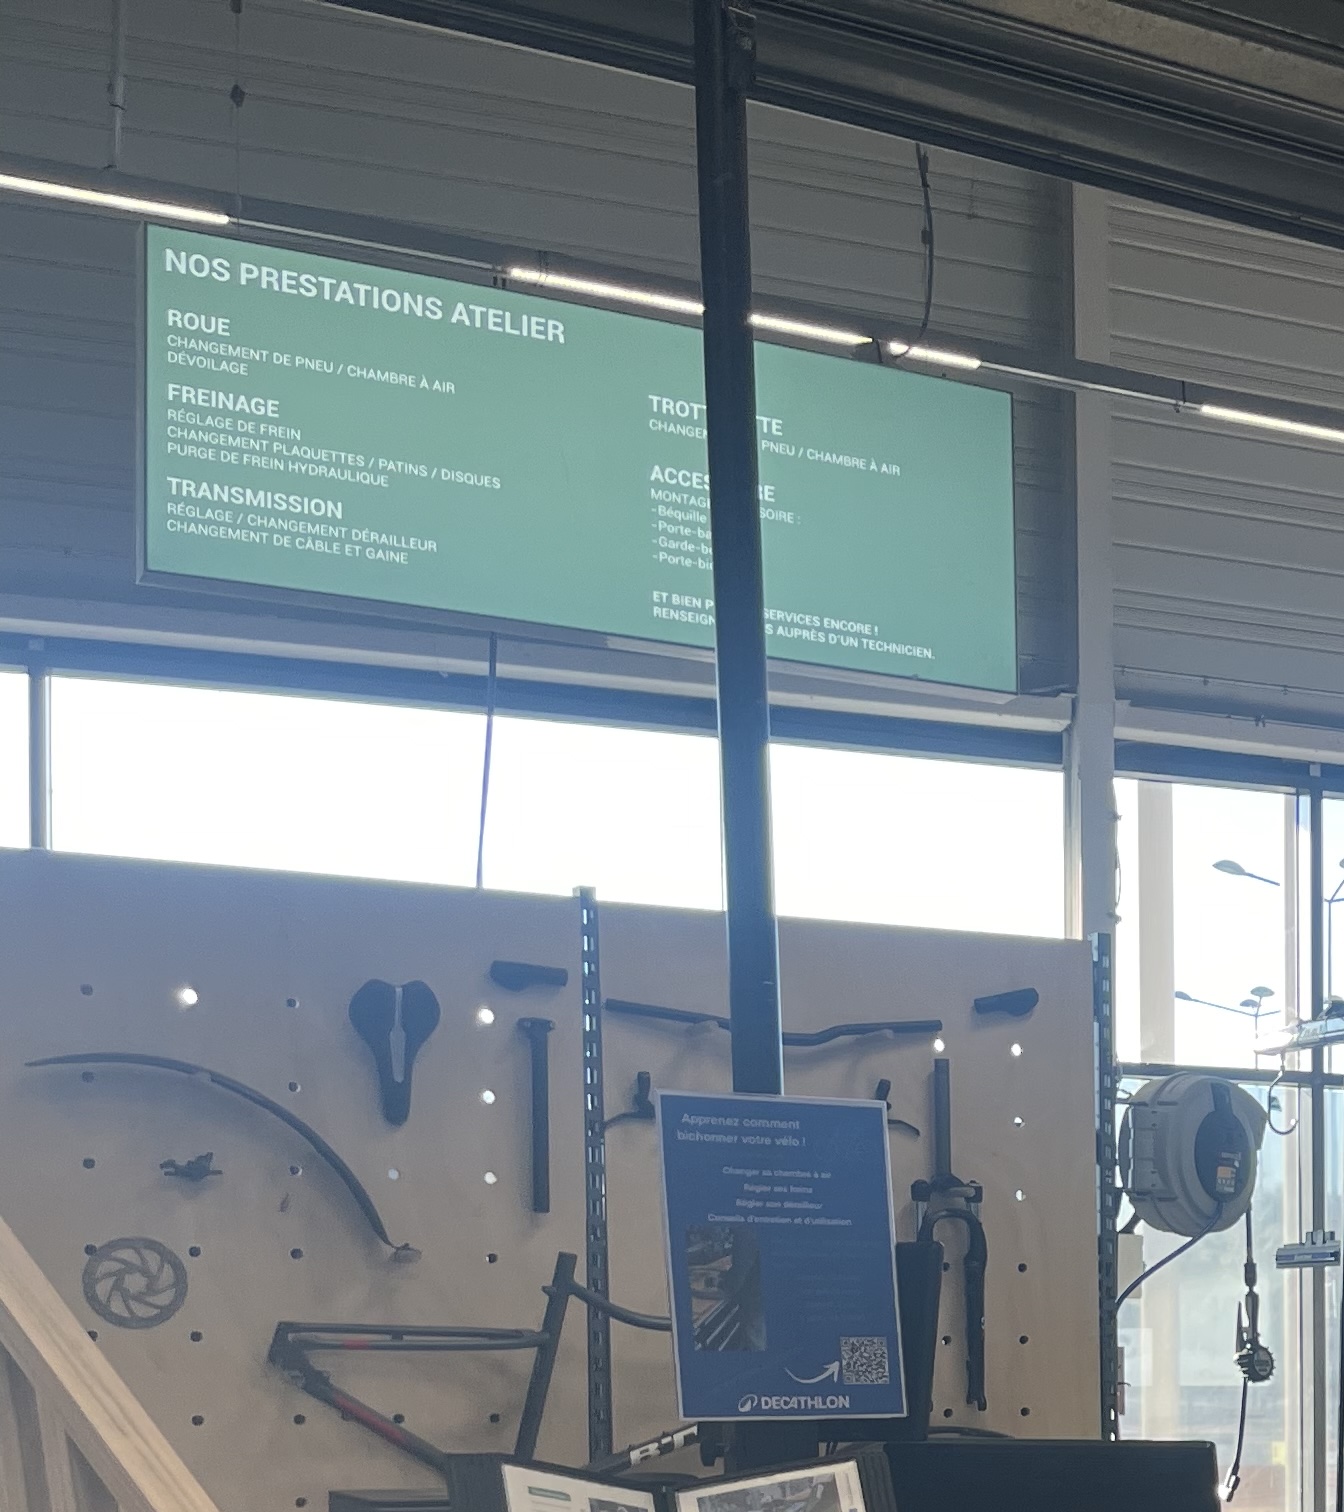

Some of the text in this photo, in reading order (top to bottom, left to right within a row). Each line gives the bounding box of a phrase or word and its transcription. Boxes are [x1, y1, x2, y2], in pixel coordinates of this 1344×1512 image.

[165, 249, 565, 343] NOS PRESTATIONS ATELIER
[167, 309, 231, 336] ROUE
[167, 349, 248, 375] DÉVOILAGE
[167, 335, 268, 363] CHANGEMENT
[273, 352, 292, 366] DE
[295, 356, 334, 373] PNEU
[347, 365, 416, 388] CHAMBRE
[420, 375, 430, 390] À
[432, 380, 455, 394] AIR
[167, 383, 280, 417] FREINAGE
[167, 407, 301, 440] RÉGLAGE DE FREIN
[167, 426, 269, 452] CHANGEMENT
[273, 441, 365, 467] PLAQUETTES
[378, 458, 427, 476] PATINS
[441, 468, 501, 489] DISQUES
[167, 442, 389, 487] PURGE DE FREIN HYDRAULIQUE
[649, 419, 708, 440] CHANGE
[761, 439, 795, 456] PNEU
[806, 448, 866, 471] CHAMBRE
[869, 458, 878, 473] À
[881, 462, 900, 476] AIR
[167, 477, 343, 519] TRANSMISSION
[167, 501, 233, 523] RÉGLAGE
[247, 514, 348, 538] CHANGEMENT
[351, 527, 437, 552] DÉRAILLEUR
[167, 520, 409, 564] CHANGEMENT DE CÂBLE ET GAINE
[653, 591, 668, 603] ET
[671, 593, 701, 609] BIEN
[824, 617, 872, 635] ENCORE
[776, 627, 825, 643] AUPRÈS
[828, 633, 858, 648] D'UN
[862, 639, 935, 660] TECHNICIEN.
[676, 1130, 738, 1144] bichonner
[741, 1135, 771, 1145] votre
[775, 1135, 800, 1147] vélo
[682, 1113, 800, 1130] Apprenez comment
[761, 1396, 850, 1410] DECATHLON
